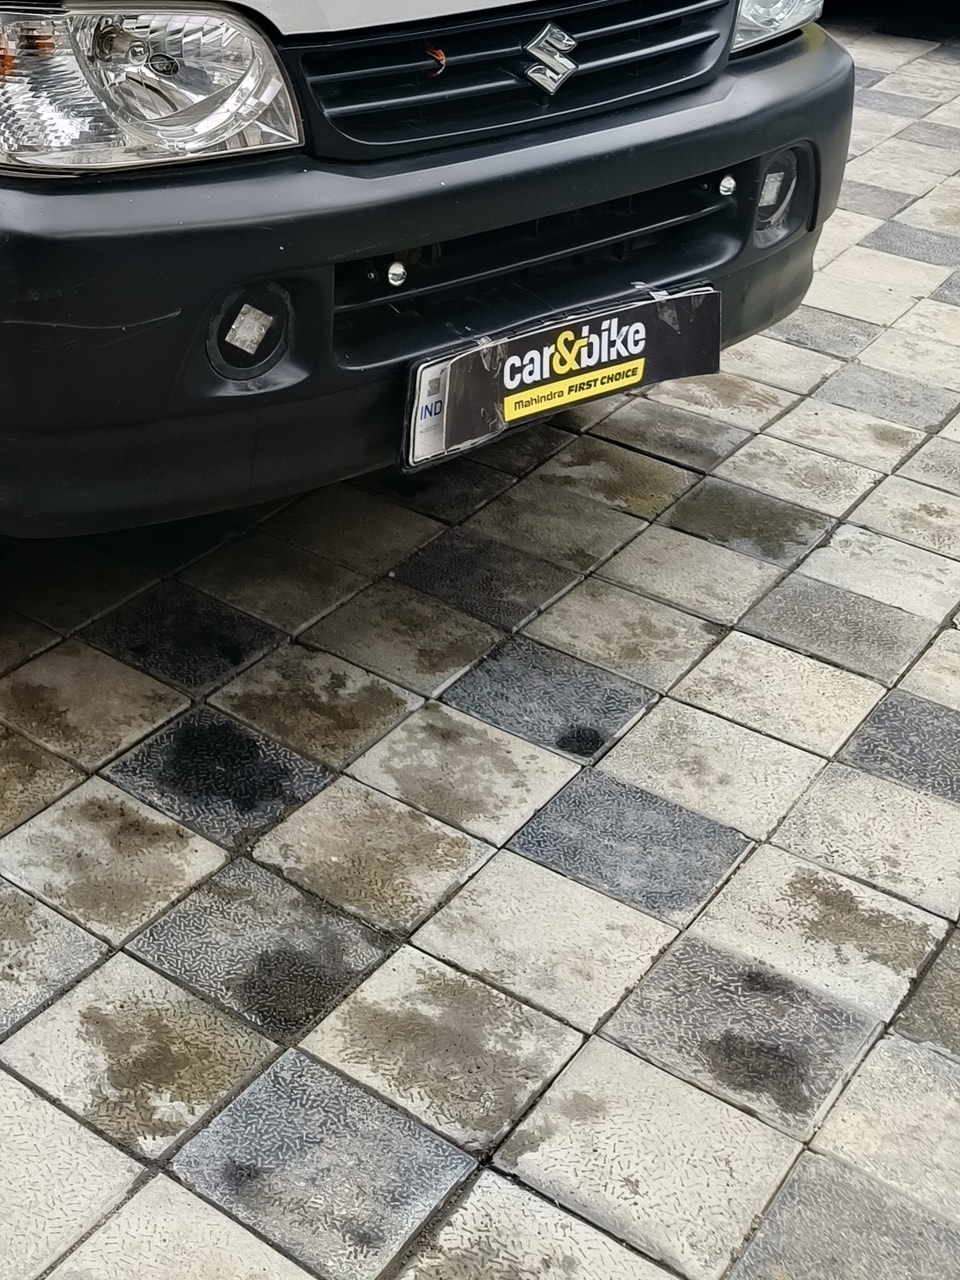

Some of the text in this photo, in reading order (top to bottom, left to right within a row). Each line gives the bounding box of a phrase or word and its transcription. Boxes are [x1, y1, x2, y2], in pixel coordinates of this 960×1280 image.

[503, 317, 646, 391] car&bike
[419, 399, 443, 421] IND
[513, 366, 639, 412] Mahindra FIRST CHOICE
